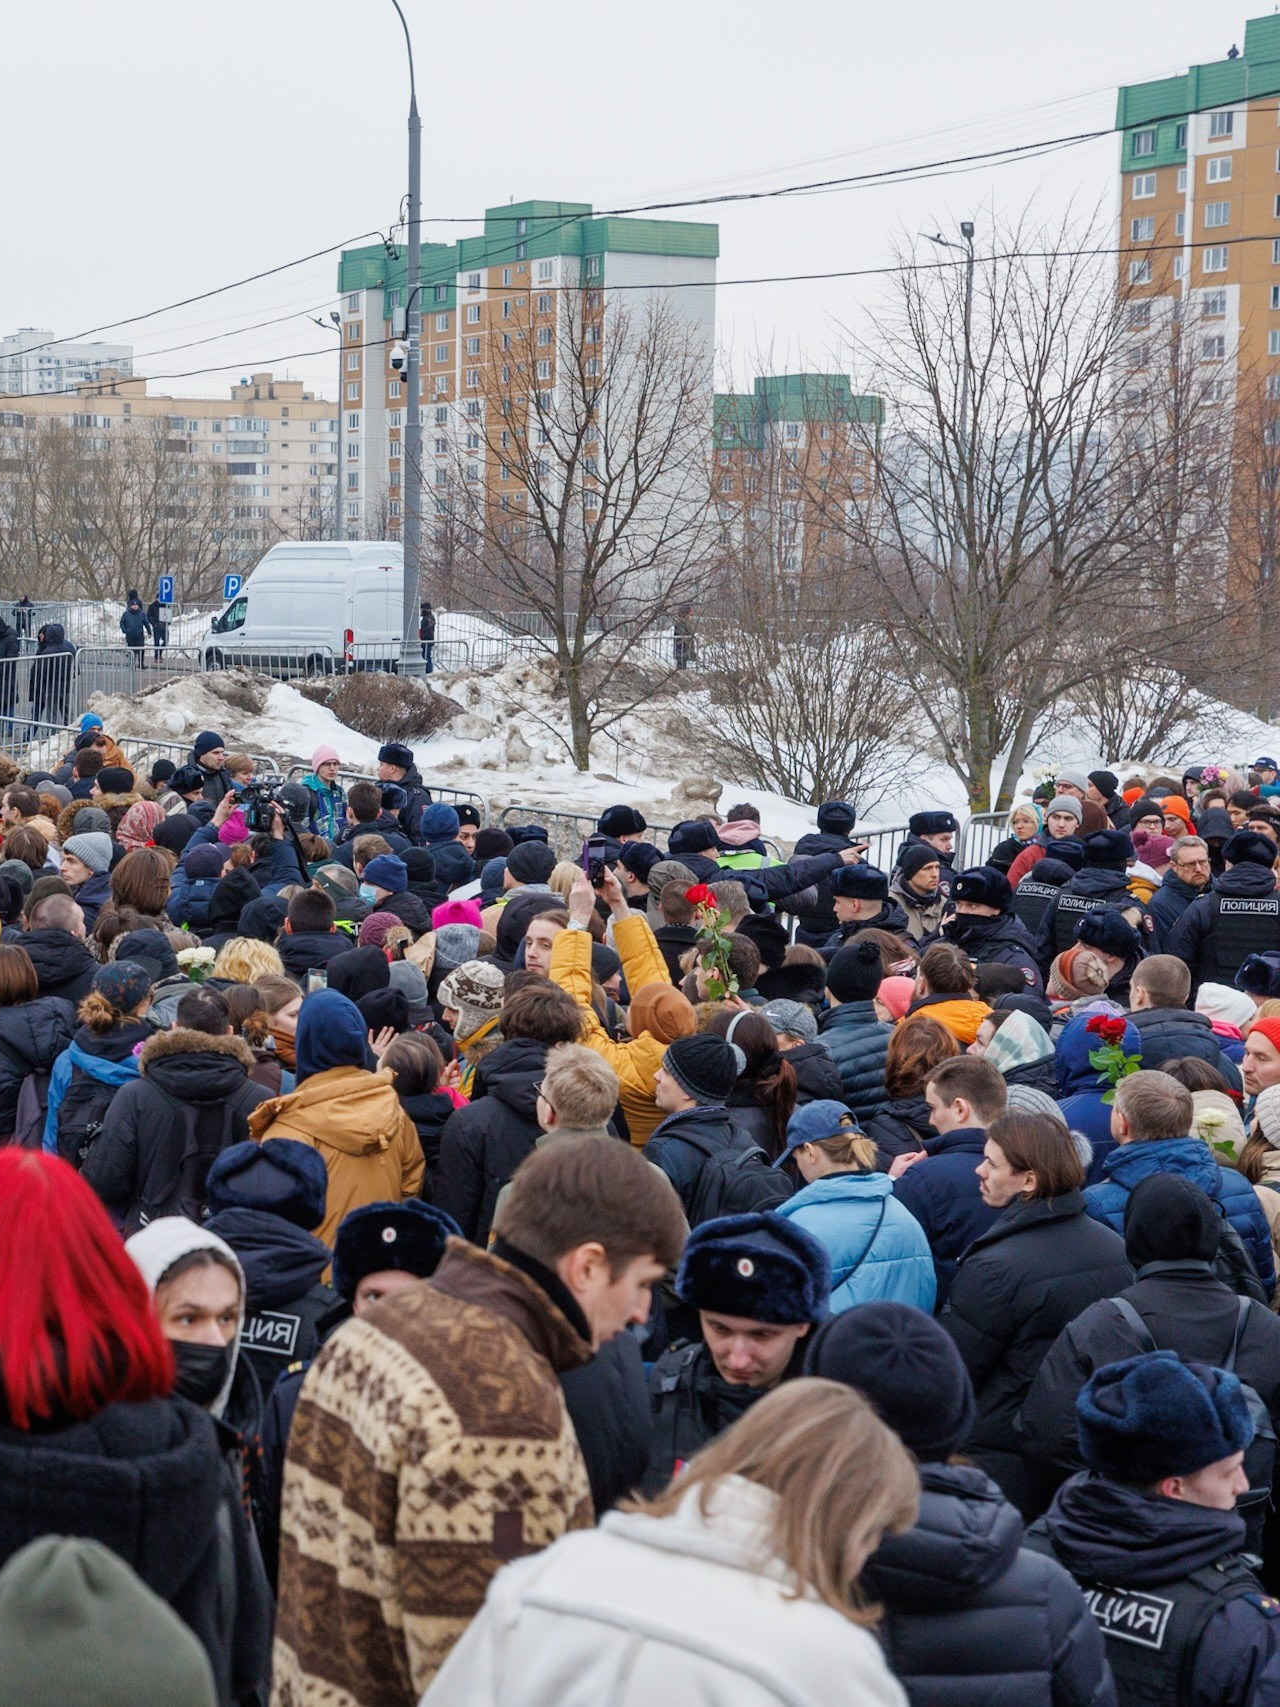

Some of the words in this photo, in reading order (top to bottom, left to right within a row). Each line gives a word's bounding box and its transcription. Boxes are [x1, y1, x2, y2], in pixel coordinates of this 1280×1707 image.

[162, 578, 172, 600] P
[227, 577, 239, 597] P
[1060, 897, 1102, 911] ПОЛИЦИ
[1222, 901, 1276, 912] ПОЛИЦИЯ
